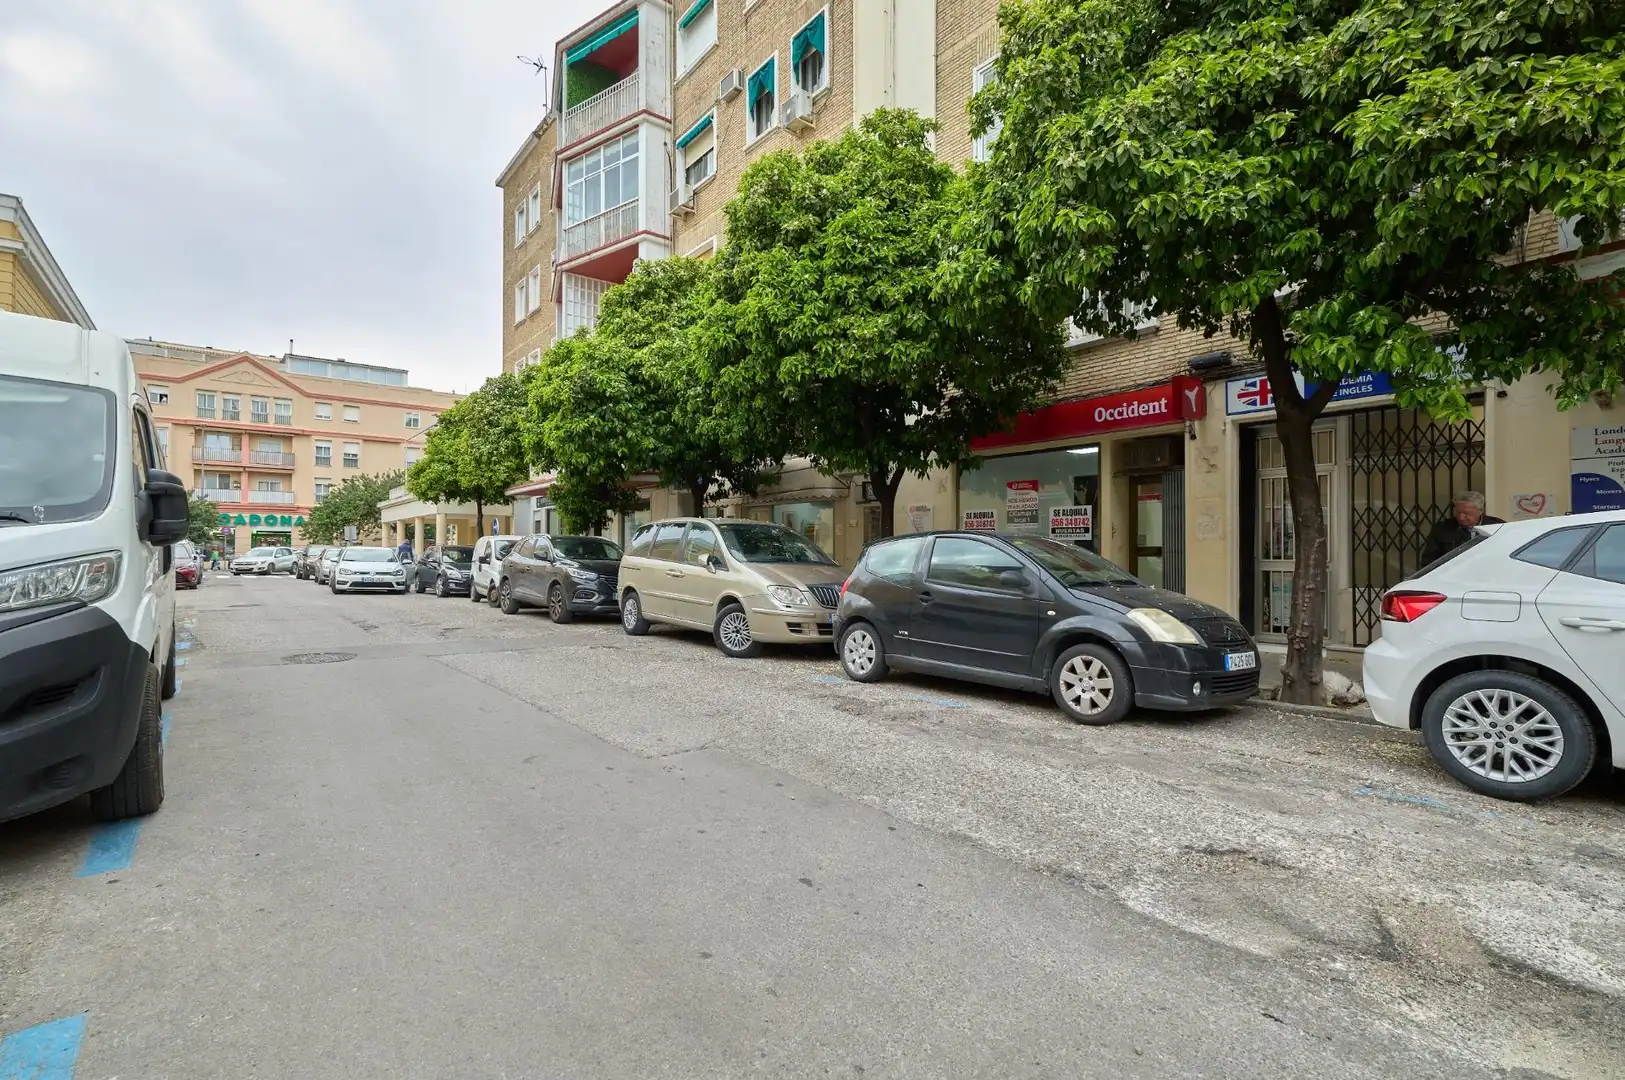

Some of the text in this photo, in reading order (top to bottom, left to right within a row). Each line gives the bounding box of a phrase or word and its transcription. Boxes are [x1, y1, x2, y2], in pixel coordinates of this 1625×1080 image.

[1339, 384, 1373, 396] INGLES
[1094, 397, 1168, 423] Occident
[1594, 425, 1625, 436] Lond
[973, 511, 994, 519] ALQUILA
[1053, 508, 1088, 517] SE ALQUILA
